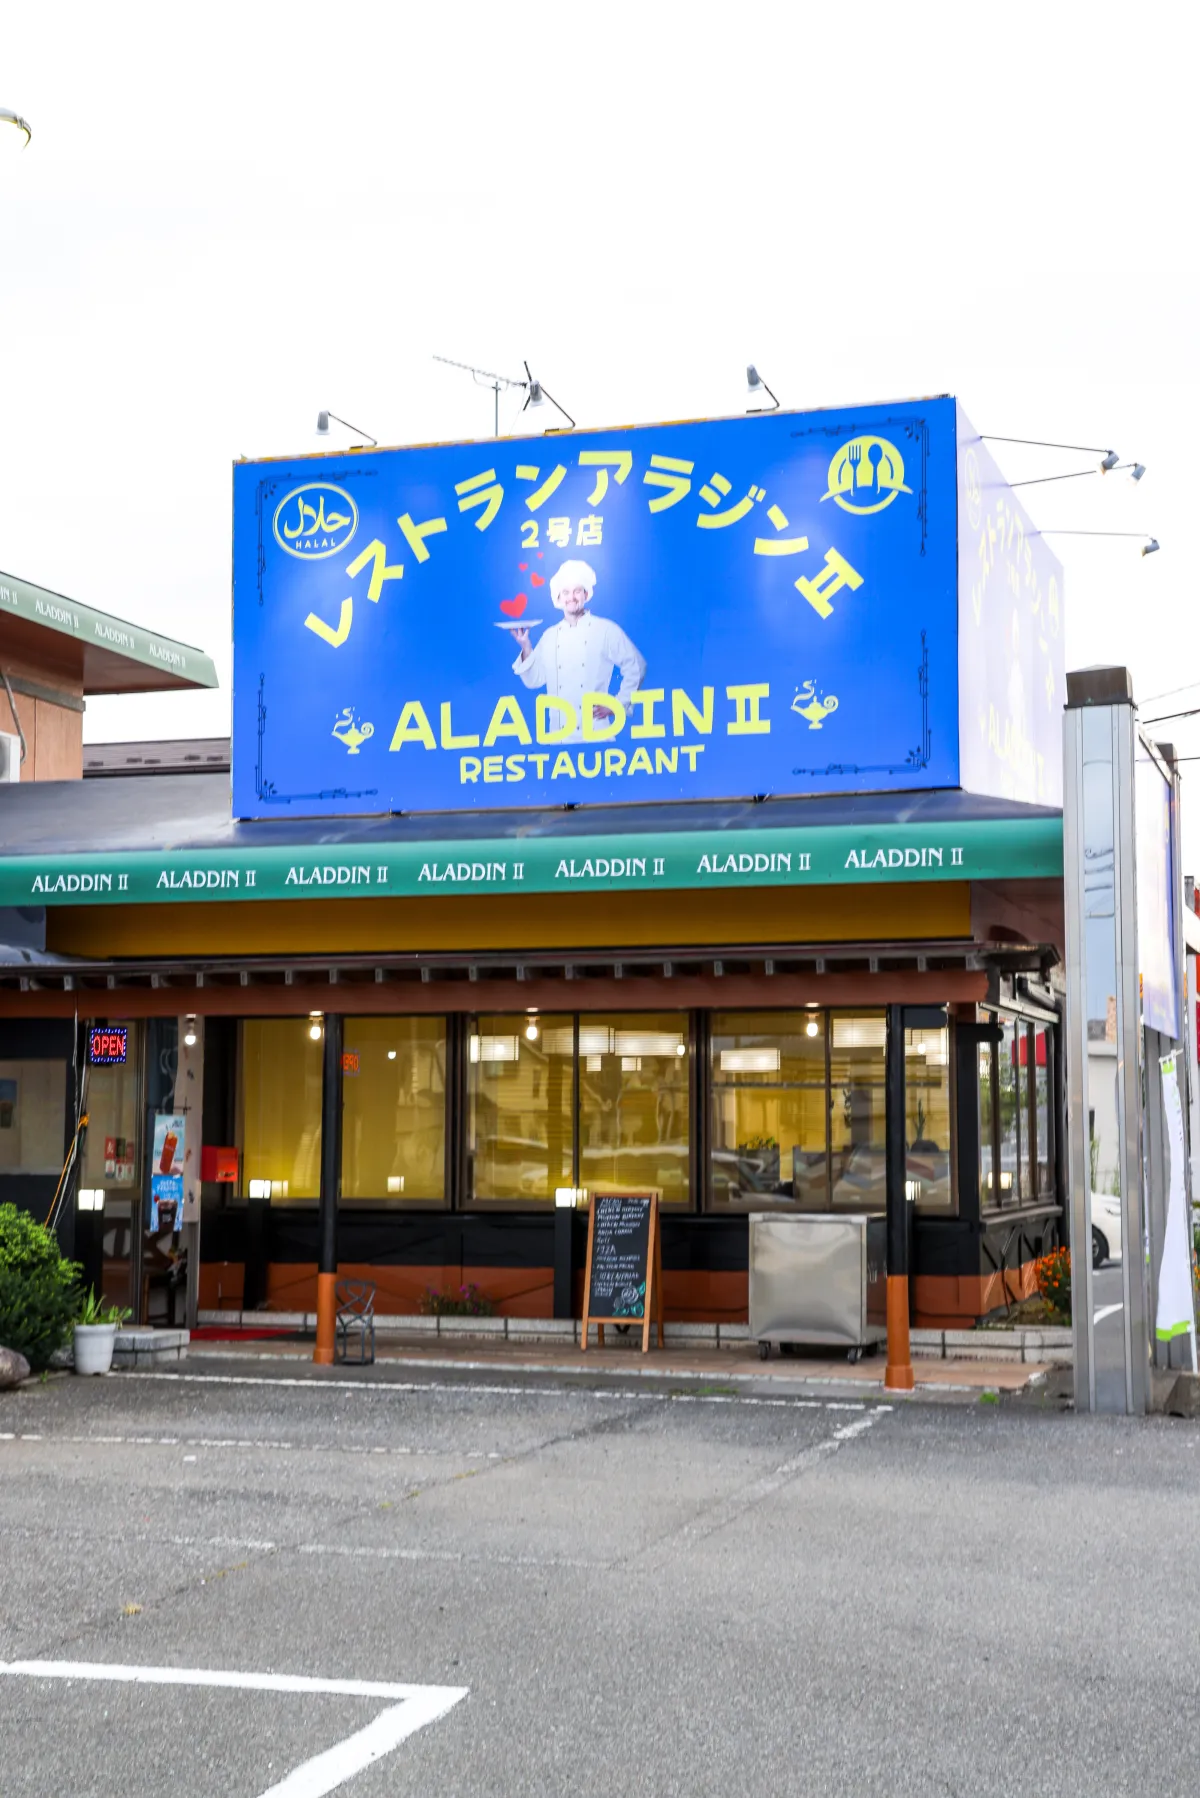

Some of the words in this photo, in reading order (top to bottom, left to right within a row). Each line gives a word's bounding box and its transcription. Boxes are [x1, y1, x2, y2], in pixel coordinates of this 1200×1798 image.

[283, 495, 351, 539] حلال
[520, 514, 604, 549] 2号店
[295, 537, 336, 550] HALAL
[35, 599, 72, 627] ALADDIN
[95, 621, 129, 648] ALADDIN
[389, 686, 715, 752] ALADDIN
[459, 744, 706, 784] RESTAURANT
[554, 857, 647, 878] ALADDIN
[696, 852, 792, 873] ALADDIN
[844, 847, 943, 869] ALADDIN
[156, 870, 240, 889] ALADDIN
[285, 866, 371, 885] ALADDIN
[417, 862, 506, 882] ALADDIN
[31, 874, 112, 893] ALADDIN
[93, 1035, 125, 1056] OPEN
